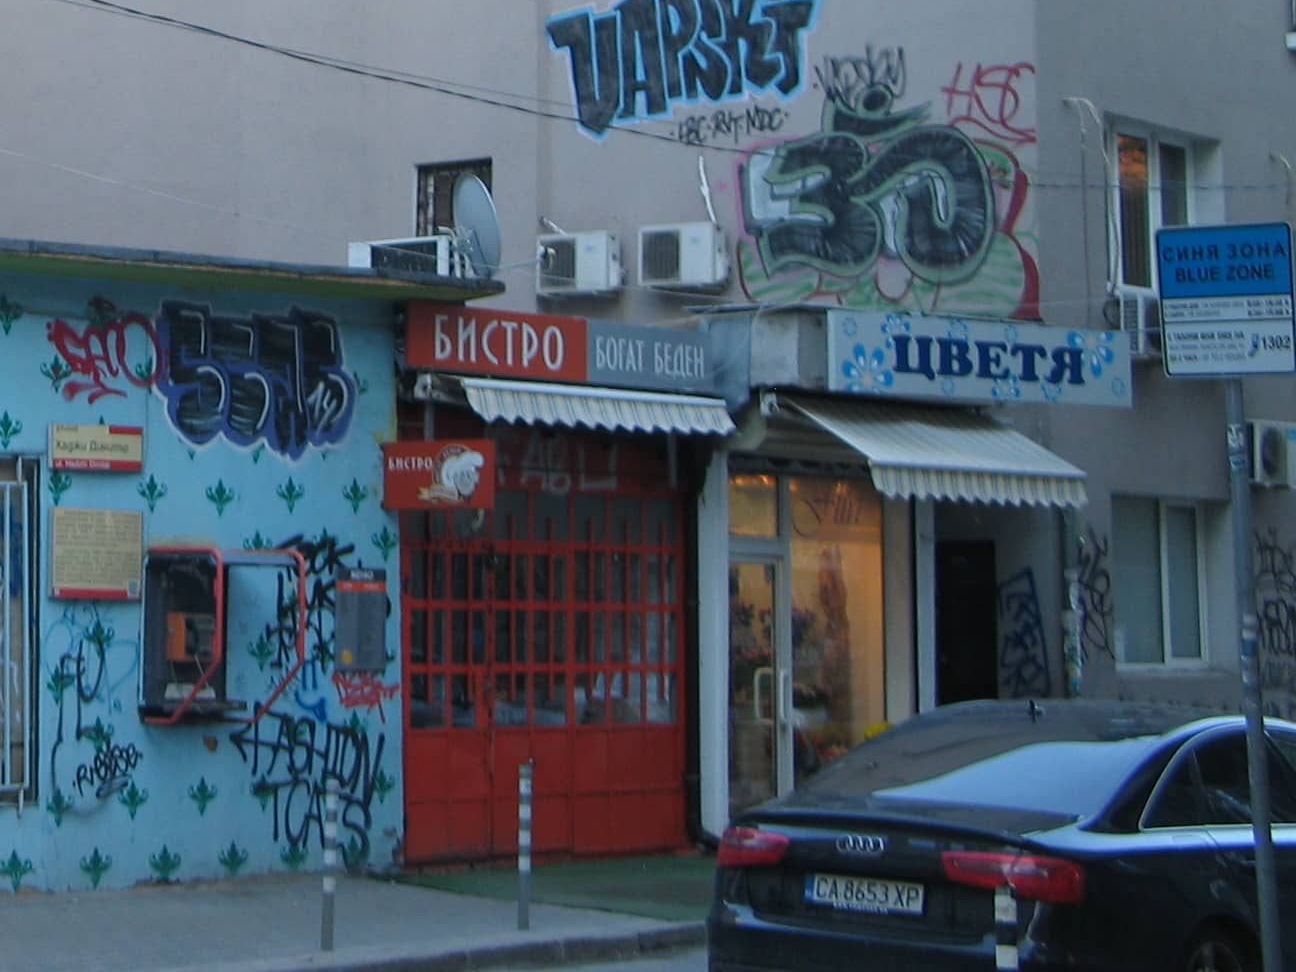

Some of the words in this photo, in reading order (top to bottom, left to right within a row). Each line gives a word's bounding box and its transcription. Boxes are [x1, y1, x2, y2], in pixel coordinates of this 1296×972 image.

[1162, 244, 1219, 263] СИНЯ
[1226, 240, 1286, 260] ЗОНА
[1175, 266, 1221, 284] BLUE
[1225, 263, 1274, 281] ZONE
[433, 313, 565, 371] БИСТРО
[595, 335, 646, 372] БОГАТ
[653, 341, 705, 379] БЕДЕН
[1262, 333, 1291, 350] 1302
[891, 333, 1086, 385] ЦВЕТЯ
[388, 455, 433, 471] БИСТРО
[816, 877, 838, 899] CA
[843, 880, 889, 904] 8653
[894, 883, 920, 908] XP
